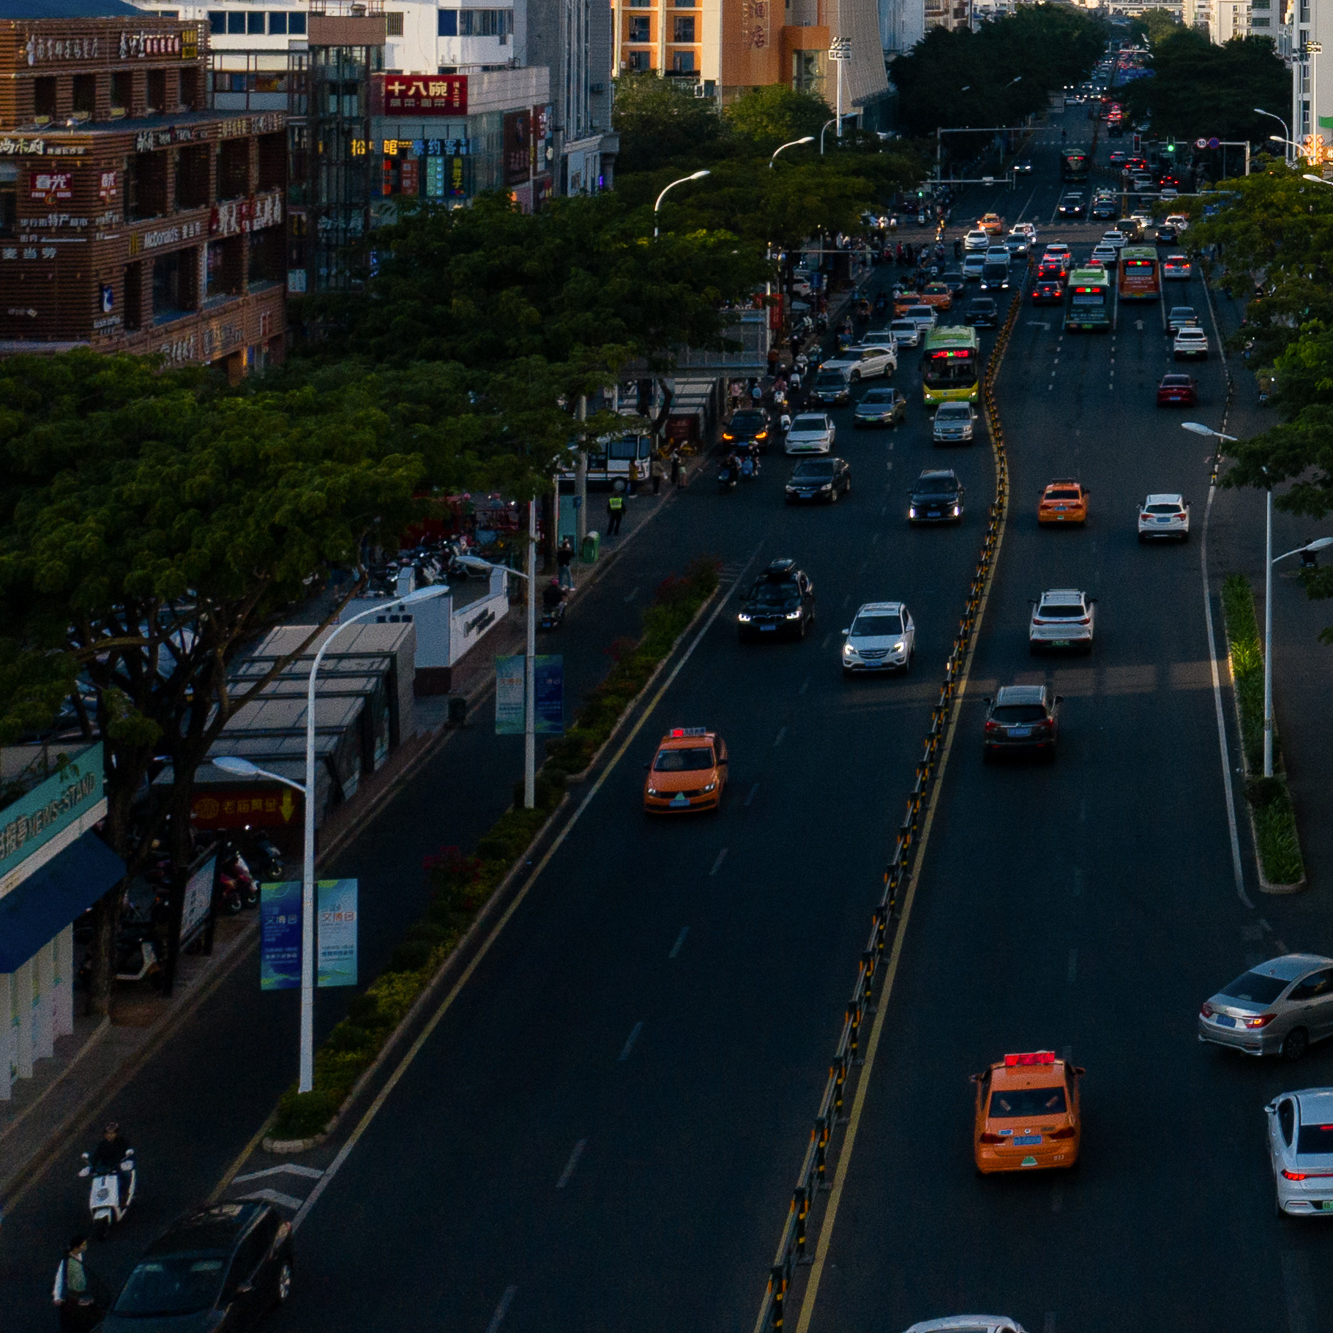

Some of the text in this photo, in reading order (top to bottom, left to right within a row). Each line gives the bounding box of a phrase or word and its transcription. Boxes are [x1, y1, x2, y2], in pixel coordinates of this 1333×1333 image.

[387, 80, 448, 97] 十八碗
[2, 247, 57, 259] 麦当劳
[28, 772, 95, 841] NEWS-STAND
